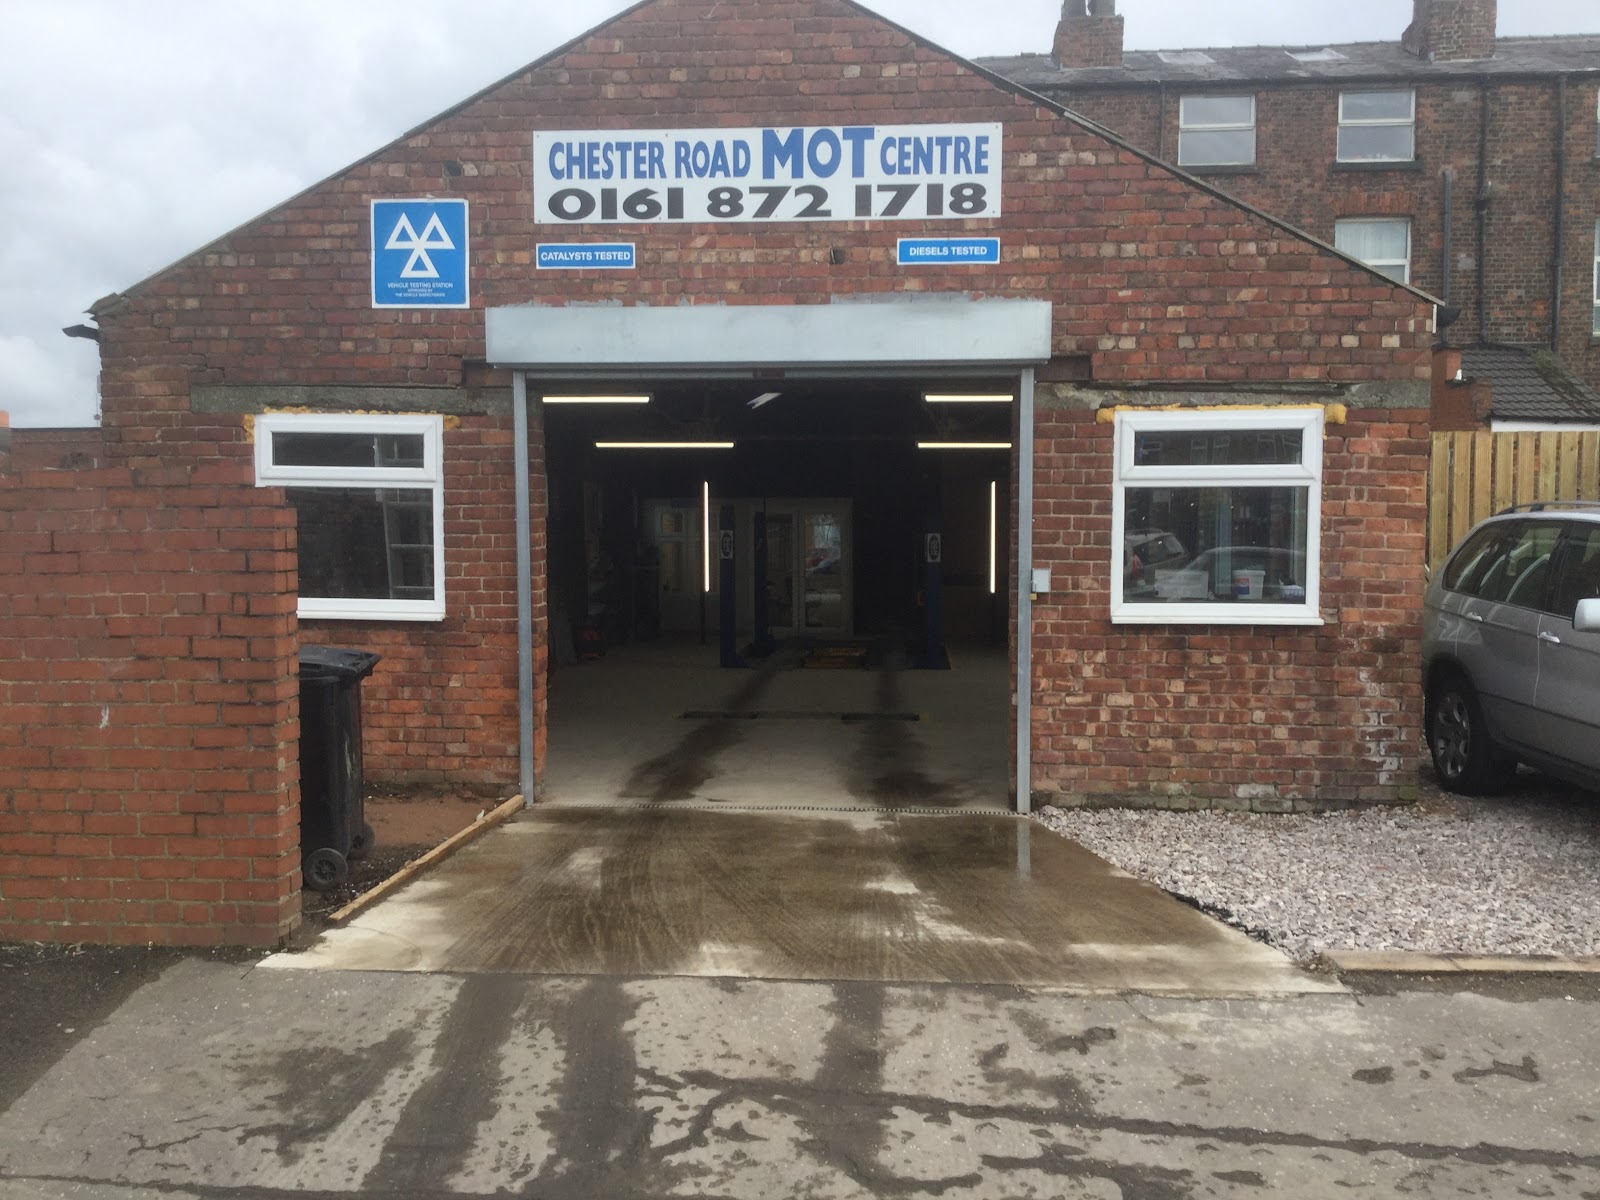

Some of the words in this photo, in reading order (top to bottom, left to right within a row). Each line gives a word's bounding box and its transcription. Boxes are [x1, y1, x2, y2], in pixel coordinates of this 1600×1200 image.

[548, 141, 667, 180] CHESTER
[674, 140, 751, 179] ROAD
[762, 127, 875, 180] MOT
[880, 136, 990, 176] CENTRE
[547, 186, 685, 221] 0161
[706, 185, 832, 219] 872
[854, 182, 988, 217] 1718
[541, 251, 593, 261] CATALYSTS
[594, 251, 631, 261] TESTED
[909, 247, 949, 256] DIESELS
[950, 246, 988, 256] TESTED
